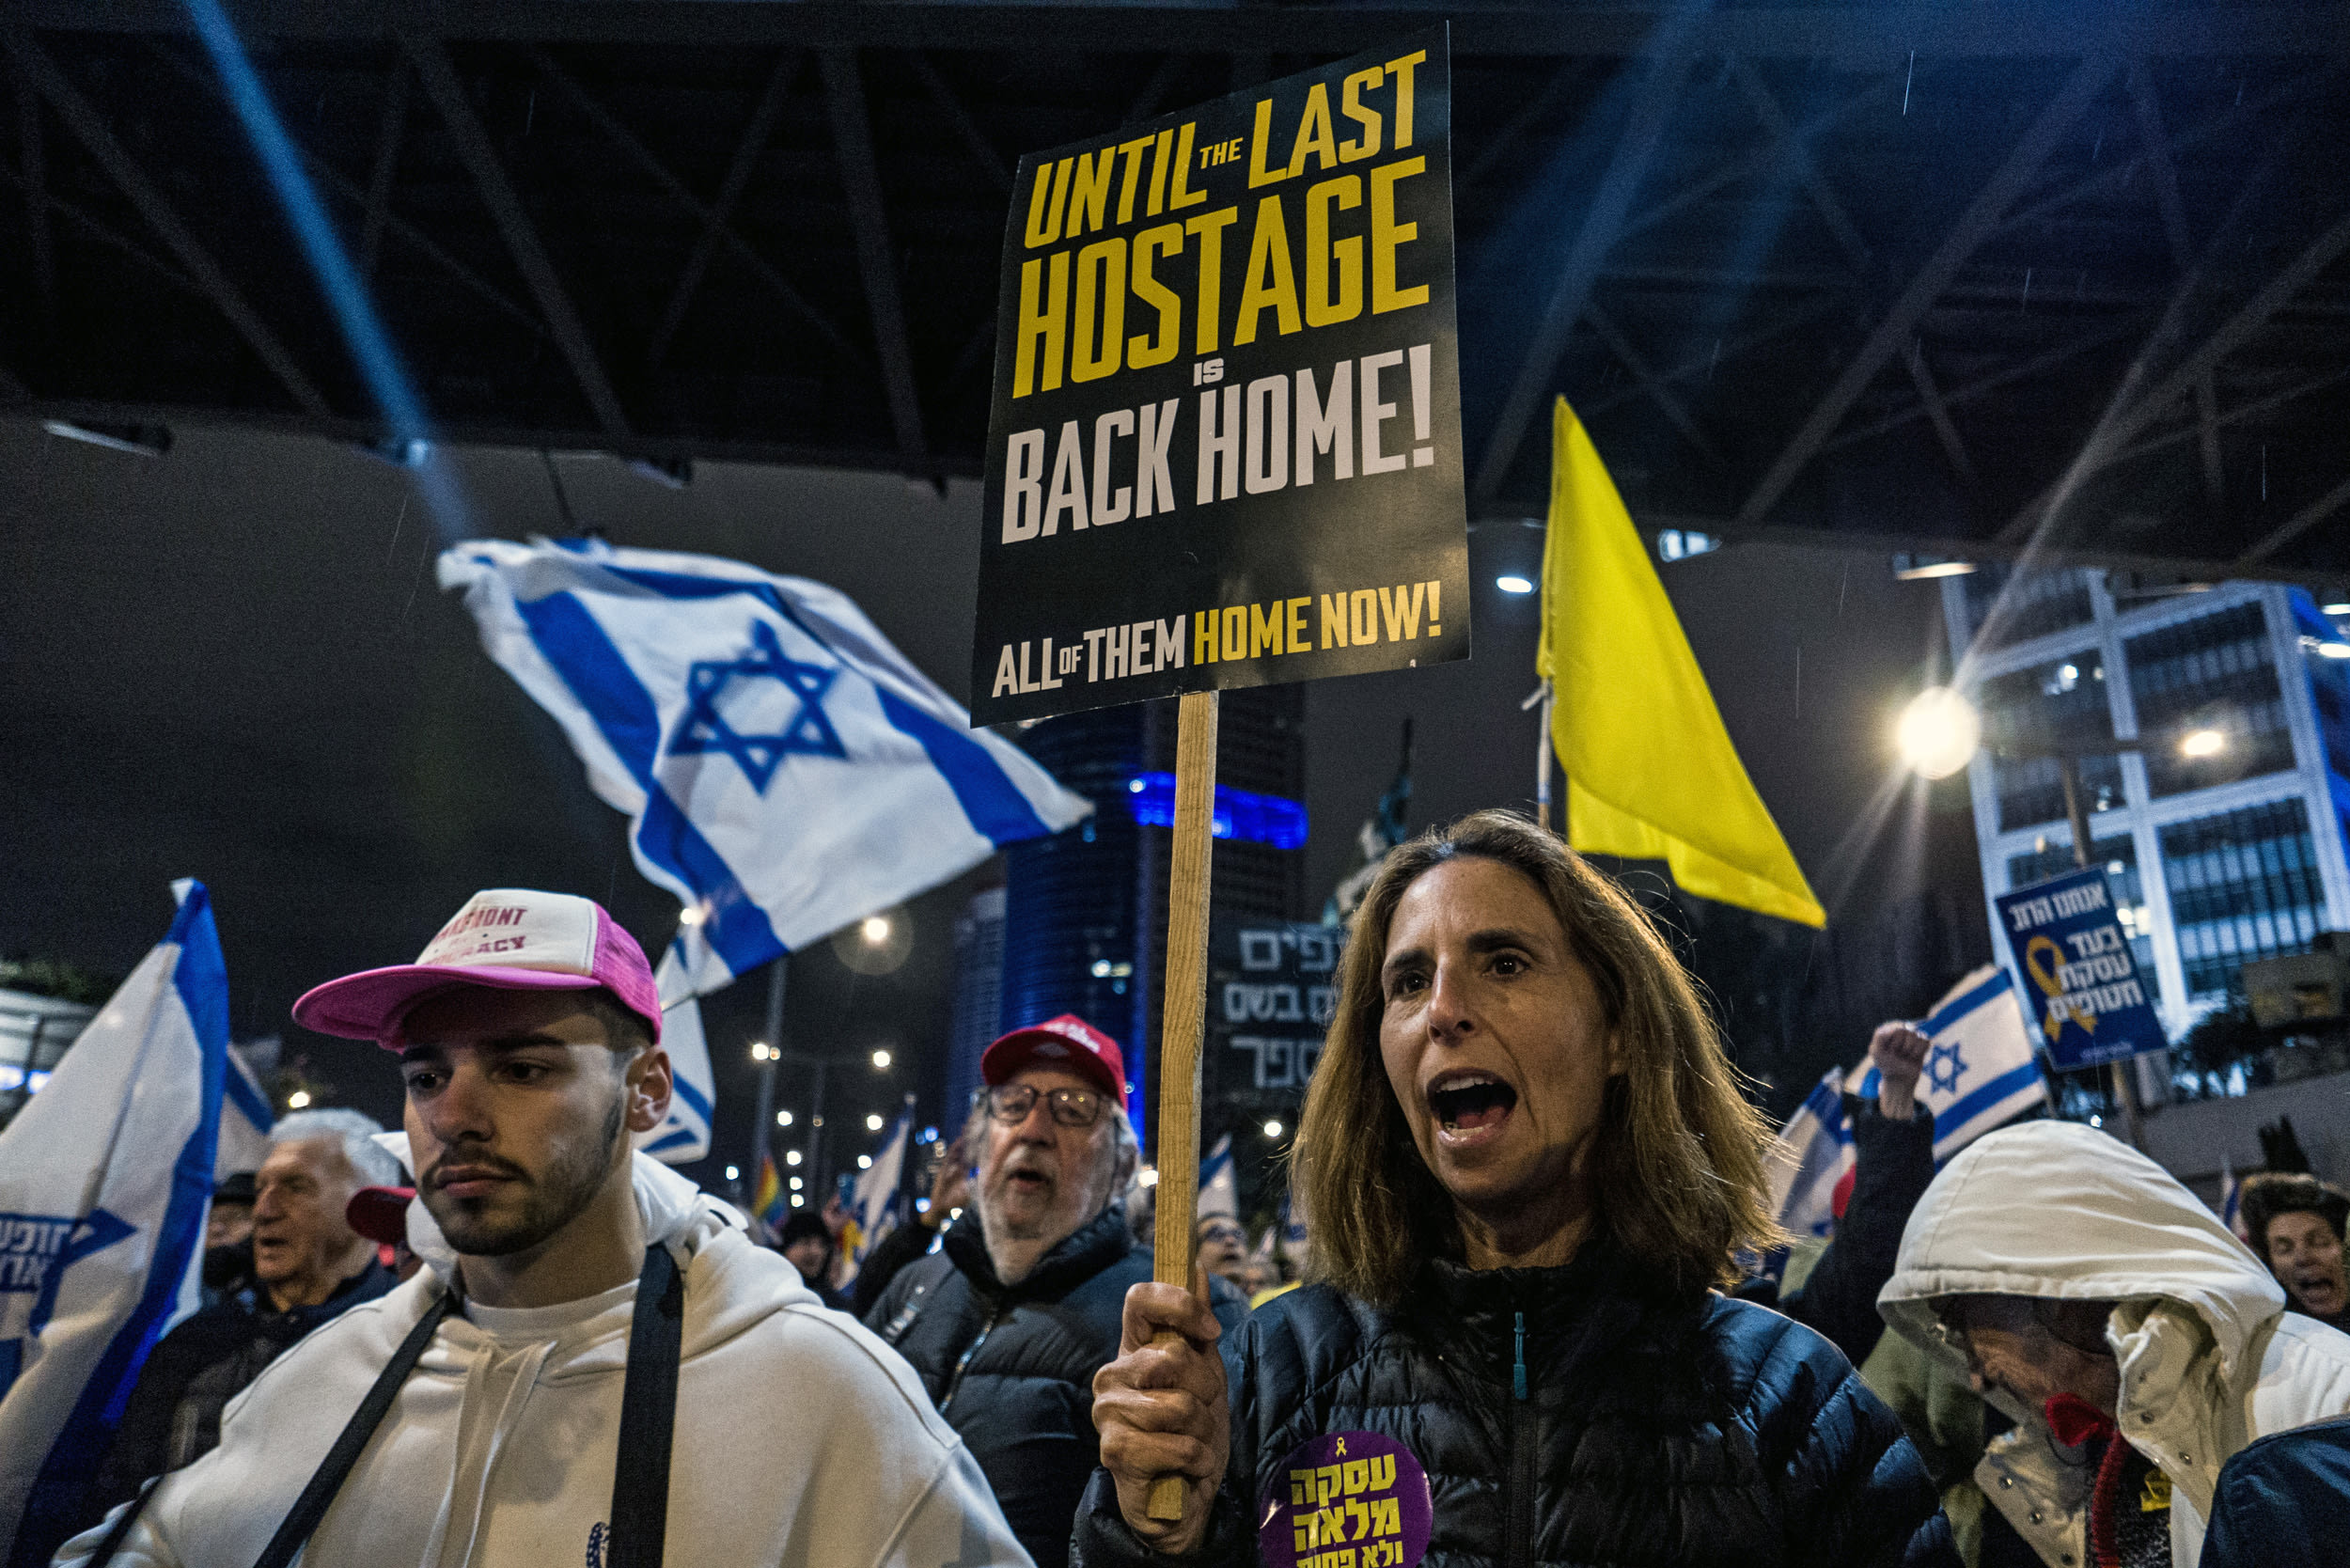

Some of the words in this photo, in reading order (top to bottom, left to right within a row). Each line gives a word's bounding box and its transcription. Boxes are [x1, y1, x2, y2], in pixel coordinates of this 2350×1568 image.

[1025, 122, 1207, 248] UNTIL
[1200, 137, 1243, 168] THE
[1248, 50, 1425, 189] LAST
[1013, 156, 1429, 399] HOSTAGE
[1194, 358, 1224, 386] IS
[1002, 399, 1179, 544] BACK
[1197, 345, 1434, 505] HOME!
[993, 638, 1062, 698] ALL
[1059, 645, 1083, 674] OF
[1084, 615, 1185, 682] THEM
[1194, 596, 1311, 665] HOME
[1321, 581, 1441, 650] NOW!
[1239, 931, 1334, 971] פים
[2066, 926, 2123, 957] בעד
[2058, 951, 2131, 993] עסקת
[2046, 979, 2144, 1023] חטופים
[1290, 1453, 1397, 1506] עסקה
[1293, 1497, 1401, 1552] מלאה
[1362, 1540, 1403, 1568] ולא
